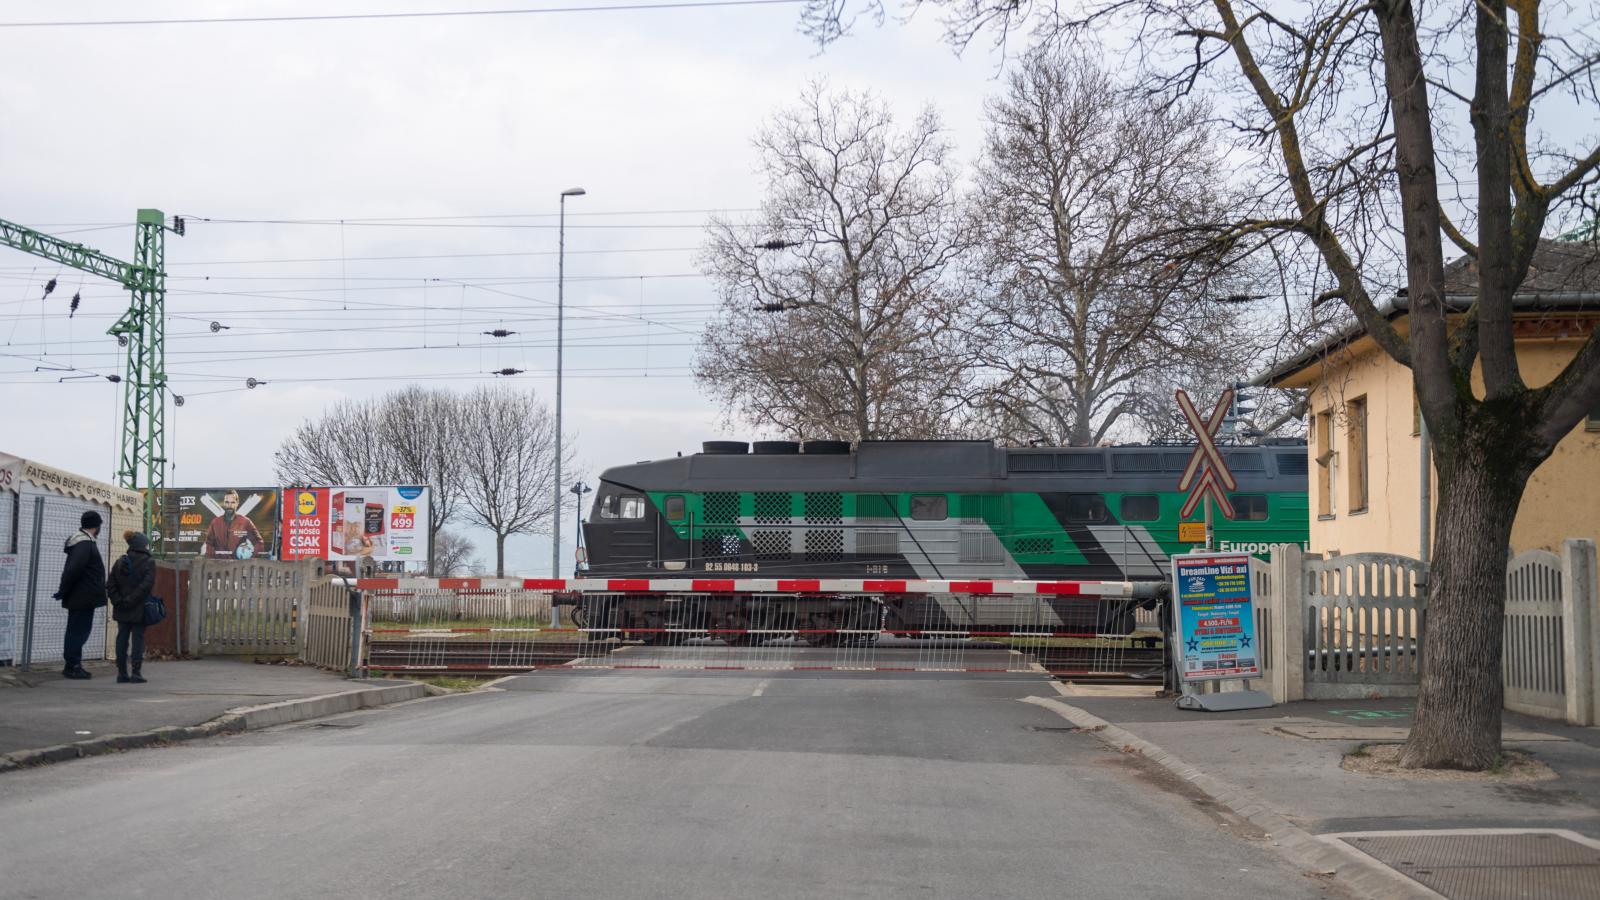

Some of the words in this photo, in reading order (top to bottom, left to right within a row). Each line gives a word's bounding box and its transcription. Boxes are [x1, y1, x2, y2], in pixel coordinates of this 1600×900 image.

[86, 485, 112, 500] GYROS
[290, 518, 320, 527] KVÁLÓ
[392, 518, 412, 528] 499
[290, 536, 320, 547] CSAK
[1180, 567, 1220, 577] DreamLine
